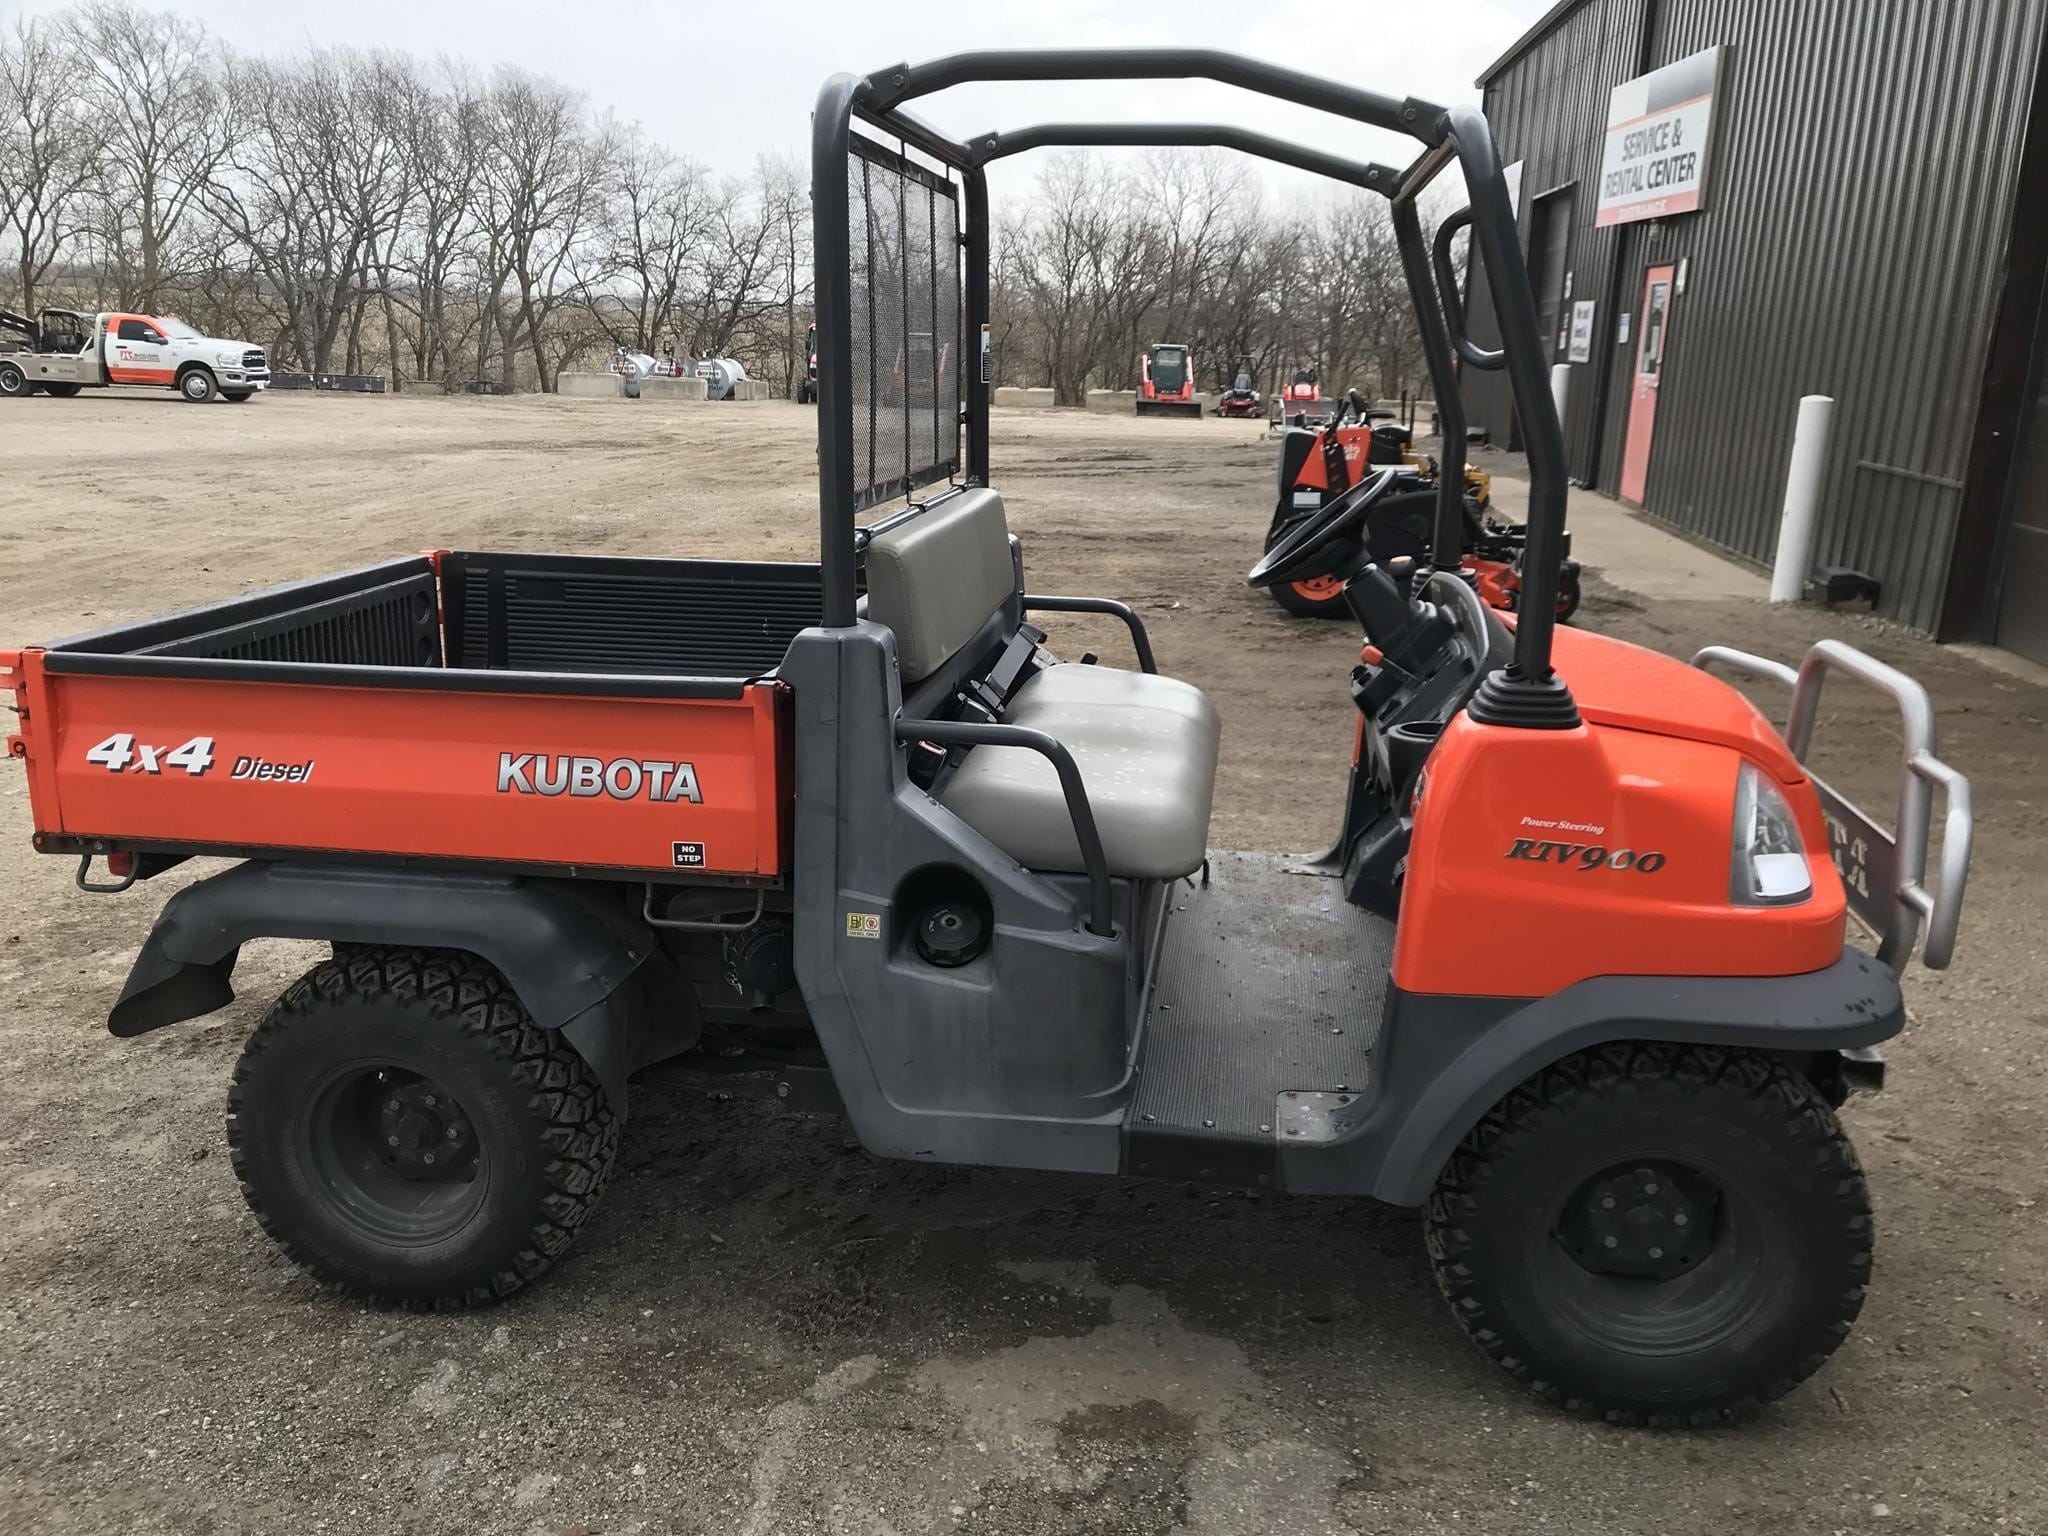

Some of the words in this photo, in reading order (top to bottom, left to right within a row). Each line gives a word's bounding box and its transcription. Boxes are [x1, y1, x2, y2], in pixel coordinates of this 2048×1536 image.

[1622, 121, 1671, 162] SERVICE
[1672, 117, 1683, 148] &
[1604, 164, 1644, 199] RENTAL
[1647, 151, 1697, 189] CENTER
[86, 733, 216, 775] 4x4
[230, 755, 315, 784] Diesel
[497, 752, 704, 804] KUBOTA
[1520, 816, 1557, 829] Power
[1557, 821, 1606, 836] Steering
[677, 854, 701, 862] STEP
[681, 845, 696, 853] NO
[1504, 837, 1667, 873] RTV900
